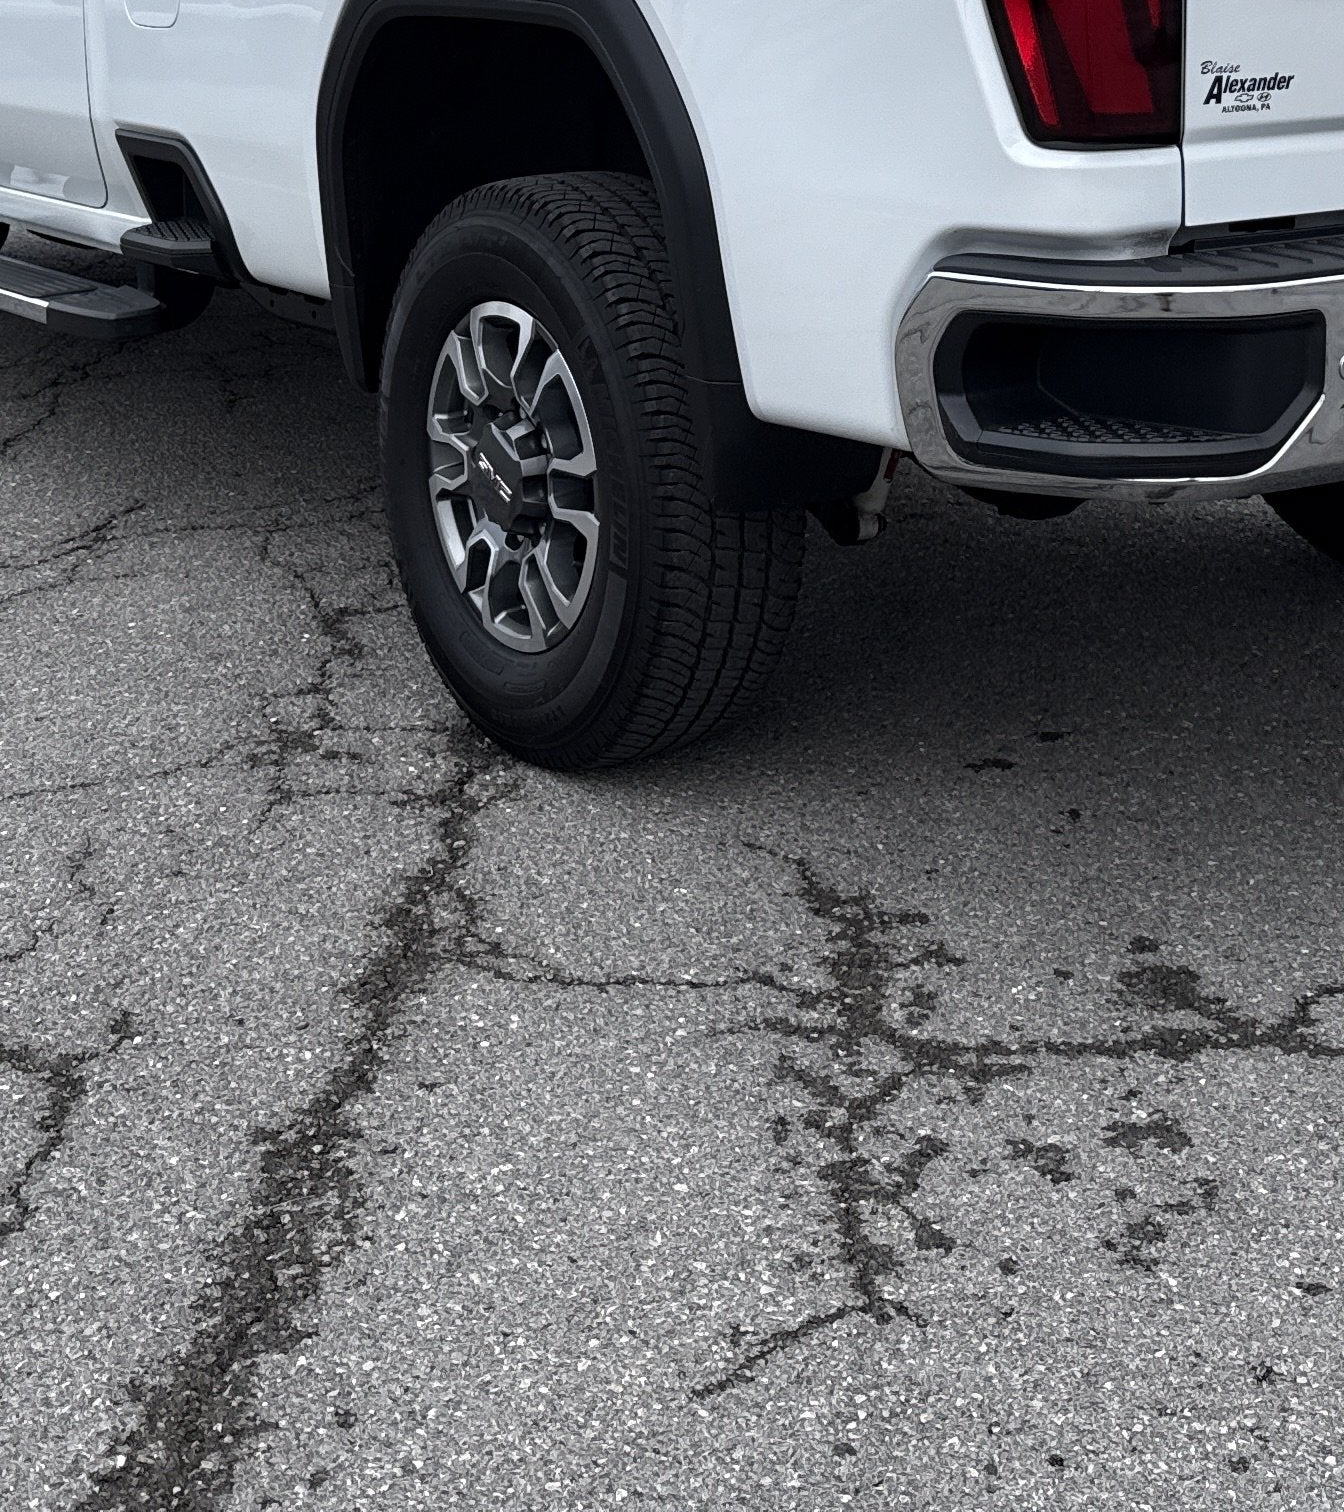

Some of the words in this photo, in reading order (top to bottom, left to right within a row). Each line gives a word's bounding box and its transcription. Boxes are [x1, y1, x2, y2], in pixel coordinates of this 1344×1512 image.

[1200, 59, 1241, 75] Blaise
[1202, 71, 1296, 105] Alexander
[1260, 102, 1271, 111] PA
